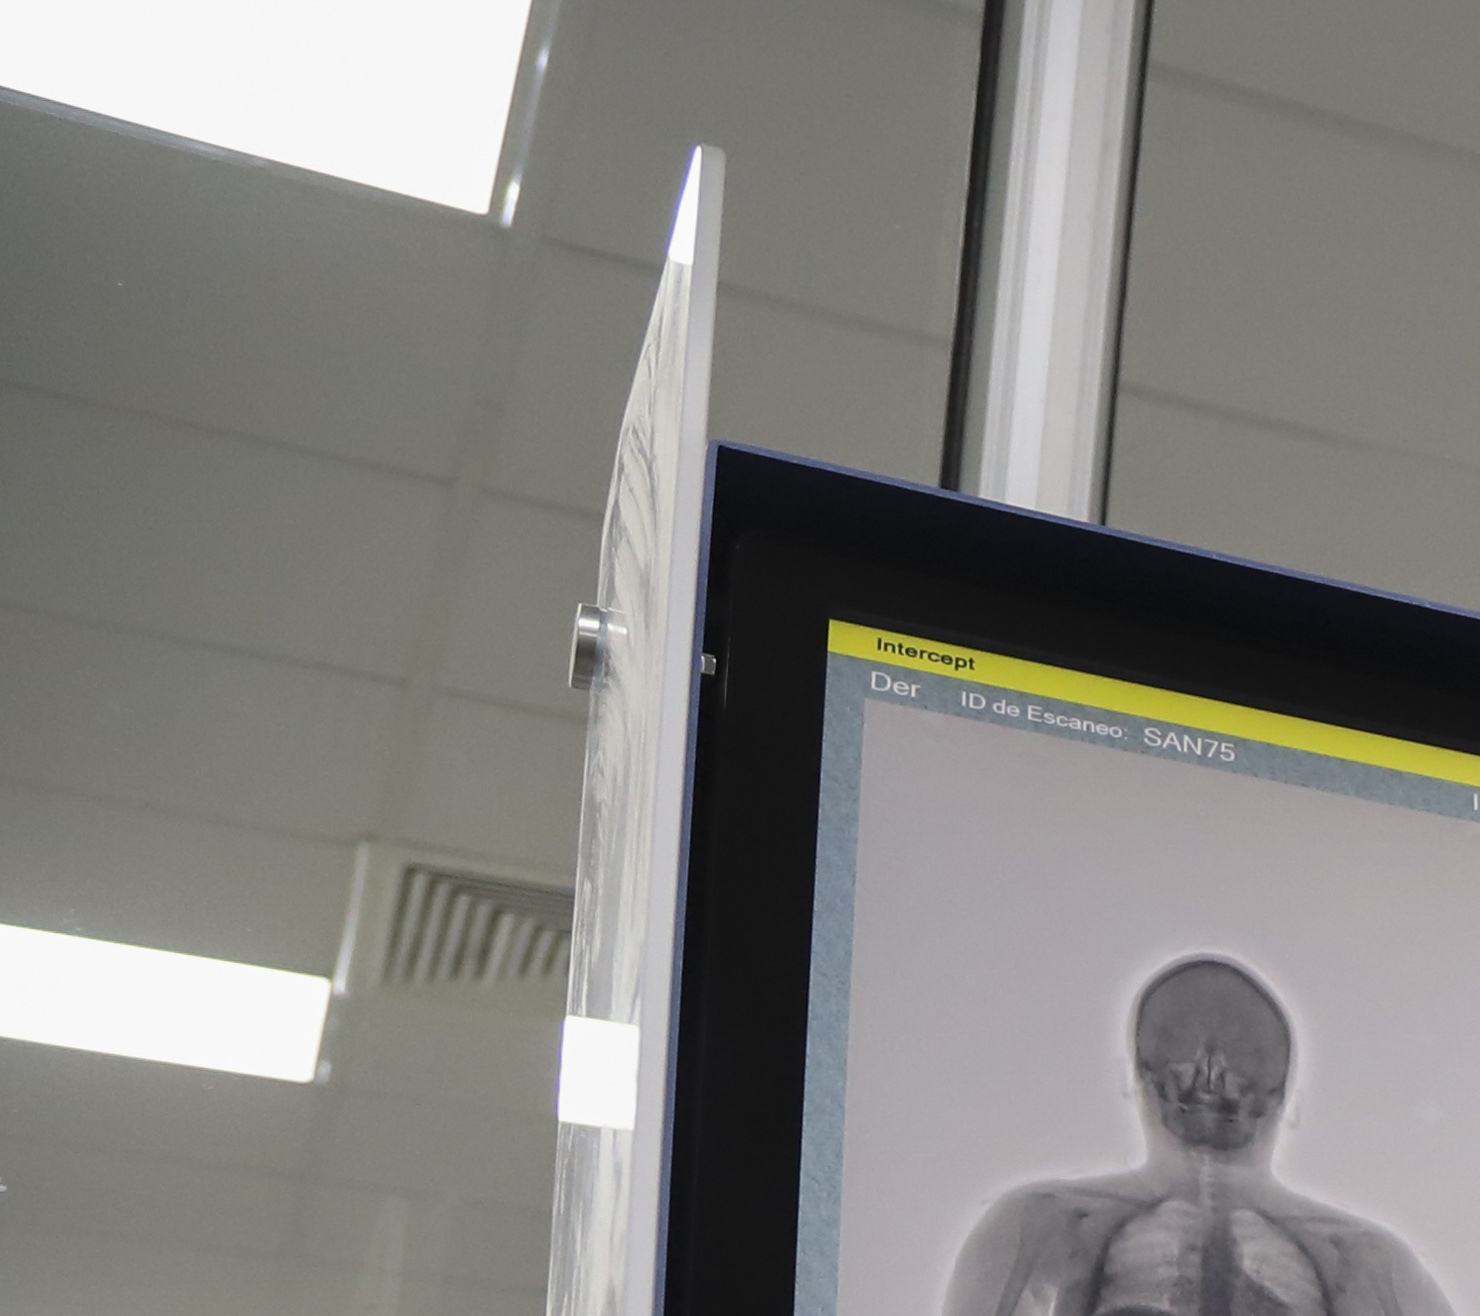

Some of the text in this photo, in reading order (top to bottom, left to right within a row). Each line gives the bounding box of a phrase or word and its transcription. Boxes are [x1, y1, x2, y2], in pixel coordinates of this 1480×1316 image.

[876, 636, 976, 672] Intercept
[870, 670, 921, 698] Der
[961, 691, 1237, 762] ID de Escaneo: SAN75
